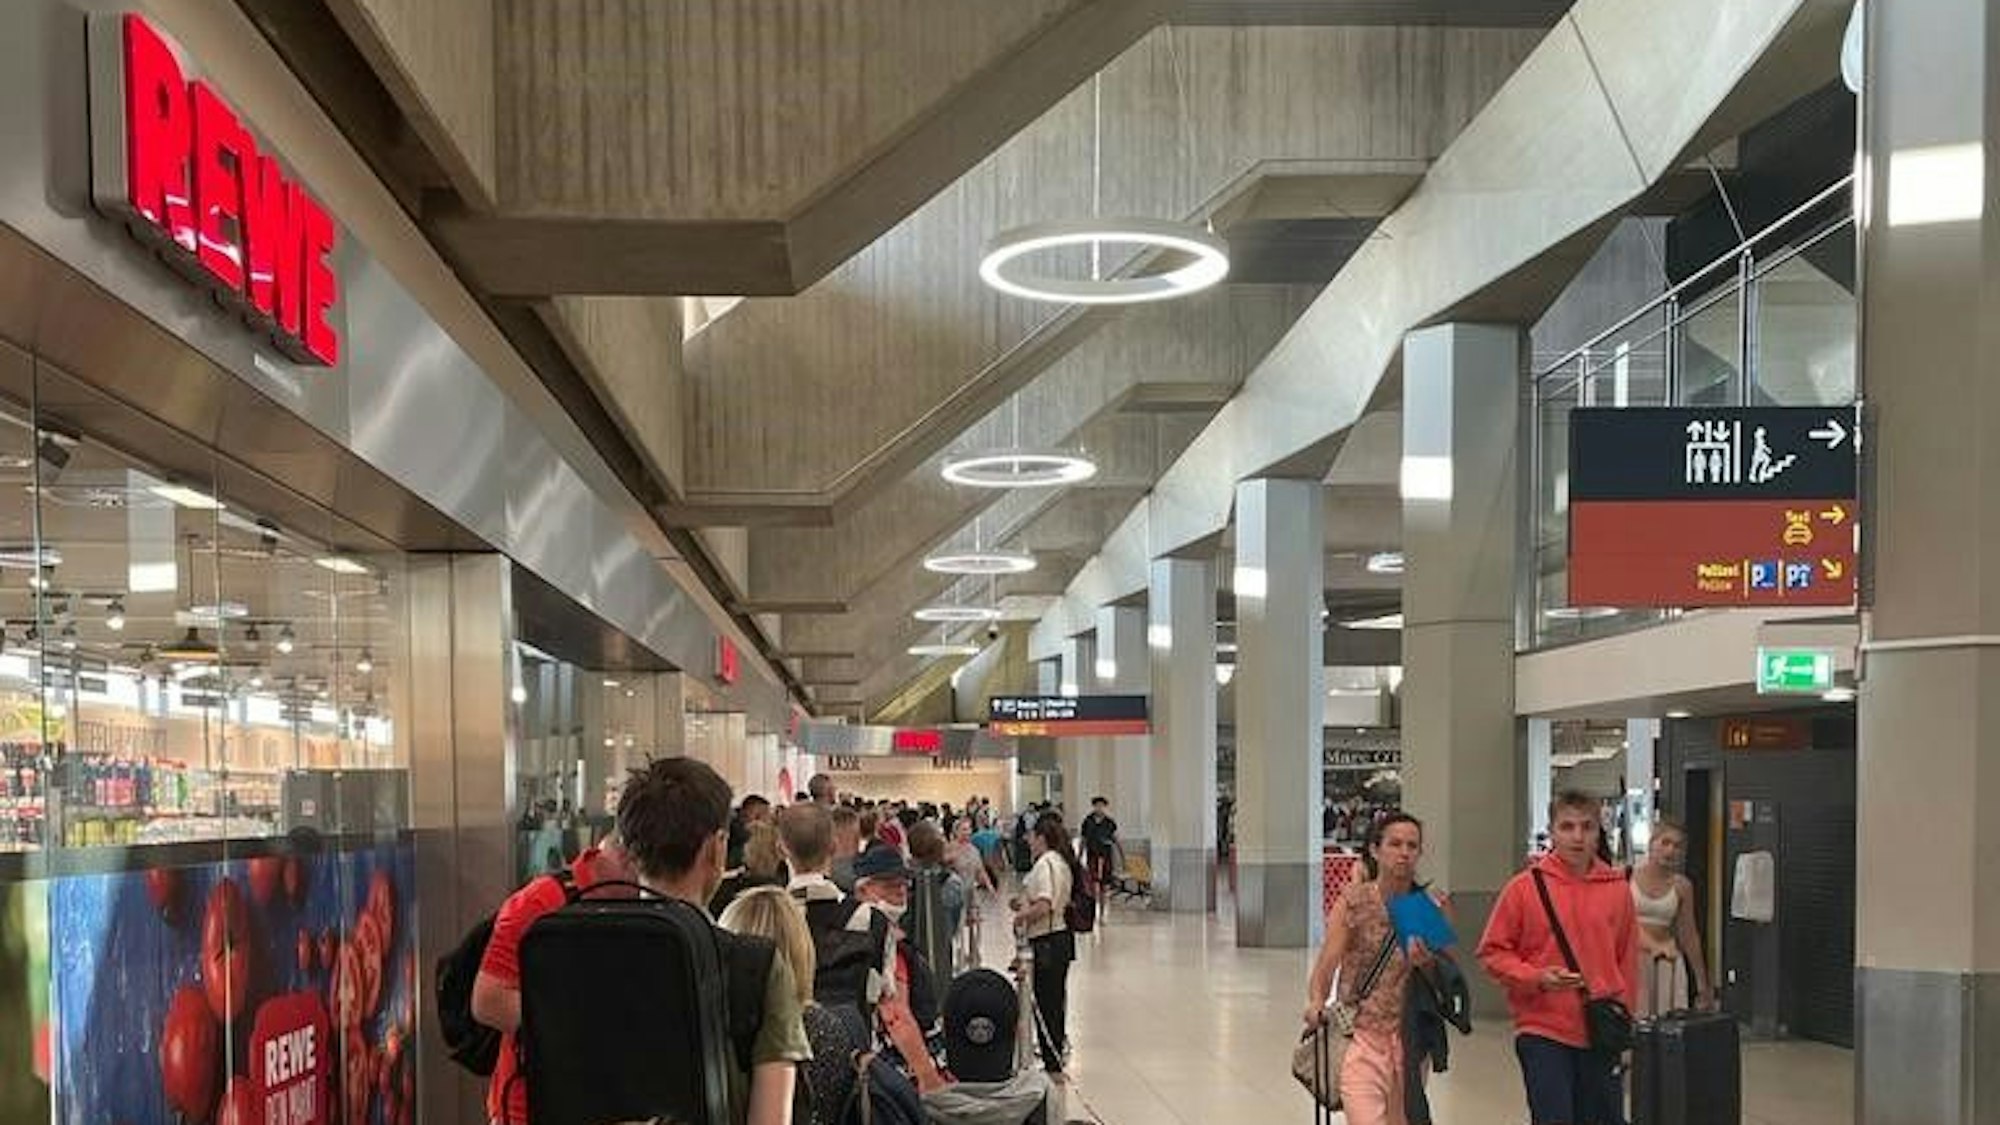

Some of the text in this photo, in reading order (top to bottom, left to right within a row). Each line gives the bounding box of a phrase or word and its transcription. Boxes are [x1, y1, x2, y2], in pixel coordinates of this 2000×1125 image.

[124, 11, 338, 367] REWE
[1697, 563, 1740, 577] Polizei
[265, 1024, 316, 1088] REWE
